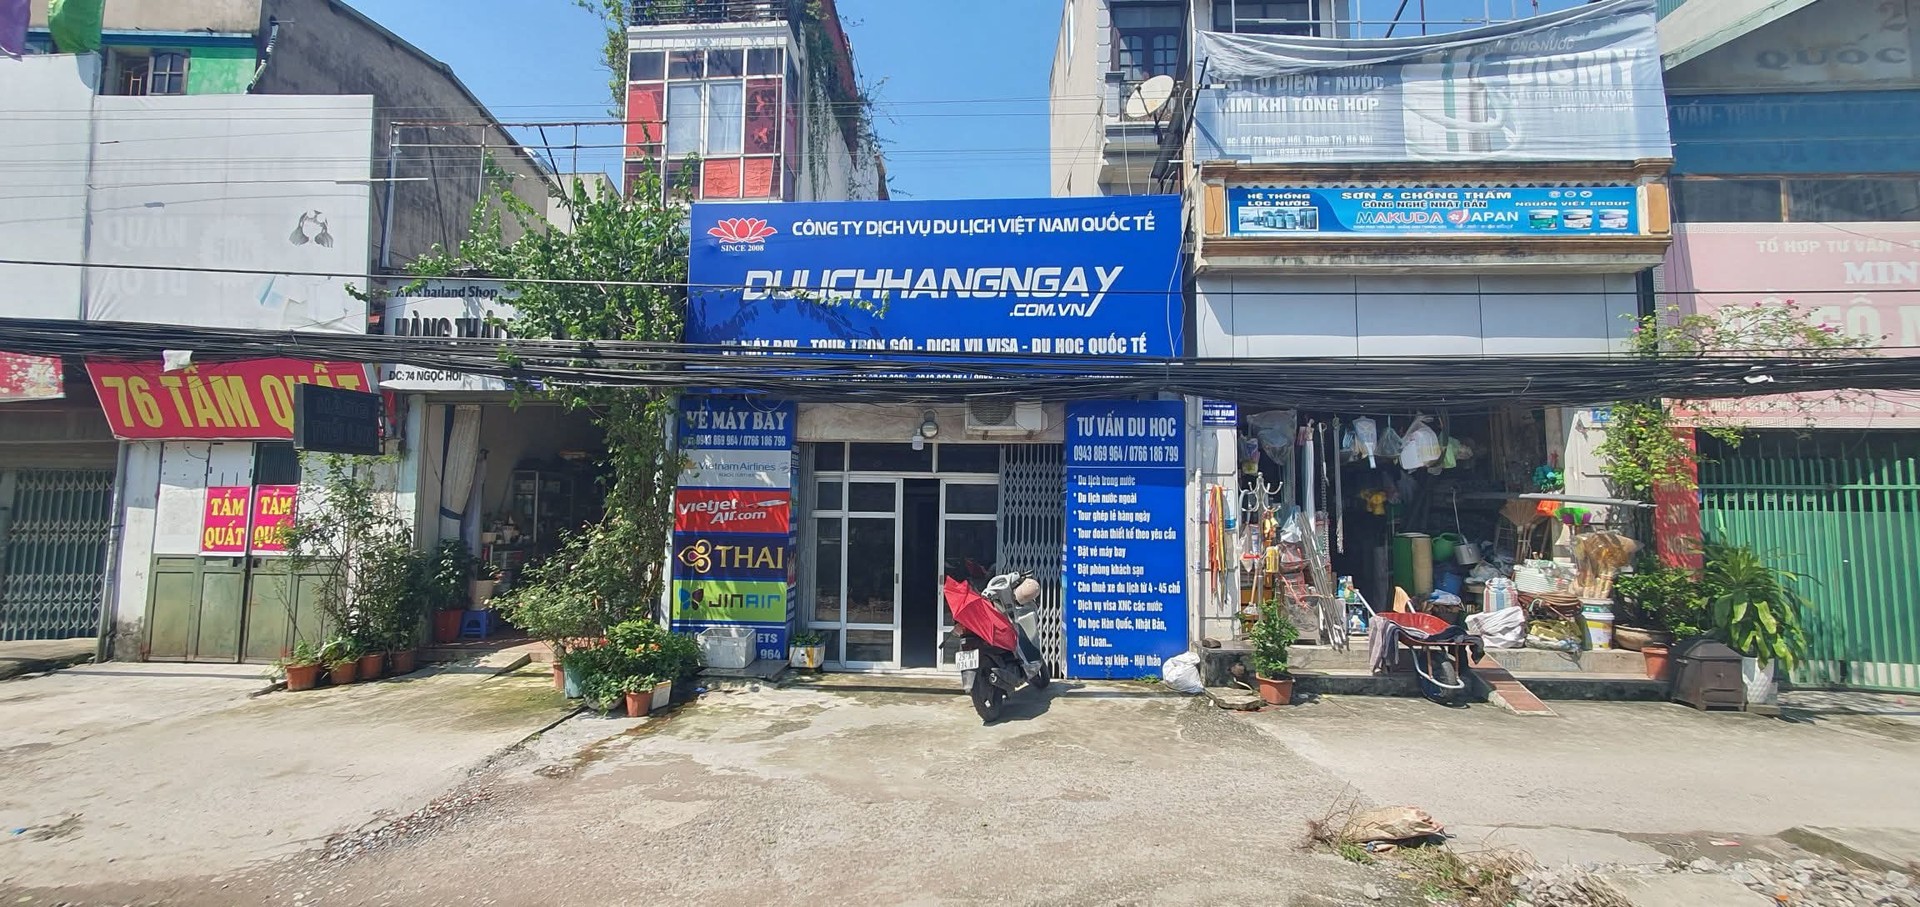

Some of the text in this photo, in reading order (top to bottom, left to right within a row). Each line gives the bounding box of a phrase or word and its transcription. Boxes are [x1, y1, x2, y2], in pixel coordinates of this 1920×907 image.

[1383, 192, 1394, 200] &
[1400, 189, 1458, 200] CHỐNG
[792, 210, 1156, 237] CÔNG TY DỊCH VỤ DU LỊCH VIỆT NAM QUỐC TẾ
[1356, 211, 1444, 224] MAKUDA
[721, 244, 764, 252] SINCE 2008
[468, 286, 498, 301] Shop
[987, 337, 1018, 353] VISA
[1032, 337, 1051, 353] DU
[1088, 332, 1127, 355] QUỐC
[1130, 332, 1147, 354] TẾ
[417, 369, 444, 383] NGỌC
[102, 374, 164, 428] 76
[711, 406, 749, 430] MÁY
[752, 411, 788, 430] BAY
[1077, 410, 1177, 441] TƯ VẤN DU HỌC
[1073, 445, 1092, 461] 0943
[1094, 445, 1107, 461] 869
[1109, 445, 1122, 461] 964
[1129, 445, 1148, 462] 0766
[1149, 446, 1163, 462] 186
[1165, 446, 1179, 462] 799
[699, 461, 776, 472] Vietnam Airlines
[1078, 475, 1086, 486] Du
[1088, 475, 1099, 488] lịch
[1101, 476, 1118, 487] trong
[1078, 492, 1137, 505] Du lịch nước ngoài
[710, 511, 767, 525] Air.com
[1078, 510, 1091, 521] Tour
[1093, 510, 1108, 522] ghép
[1118, 510, 1134, 522] hàng
[1135, 510, 1151, 523] ngày
[204, 519, 245, 549] QUẤT
[1078, 527, 1091, 539] Tour
[1110, 526, 1125, 539] thiết
[1126, 526, 1135, 539] kế
[1135, 528, 1150, 539] theo
[1151, 528, 1163, 540] yêu
[714, 545, 783, 569] THAI
[1099, 546, 1113, 558] máy
[1114, 546, 1126, 558] bay
[1090, 564, 1109, 576] phòng
[1111, 564, 1131, 575] khách
[1078, 581, 1090, 593] Cho
[1092, 582, 1106, 593] thuê
[1107, 583, 1115, 593] xe
[1116, 582, 1125, 593] du
[1126, 582, 1139, 595] lịch
[1148, 583, 1153, 594] 4
[1158, 583, 1167, 594] 45
[1078, 599, 1163, 613] Dịch vụ visa XNC các nước
[1078, 617, 1086, 629] Du
[1088, 618, 1100, 631] học
[1101, 617, 1114, 629] Hàn
[1136, 618, 1151, 632] Nhật
[1152, 617, 1167, 632] Bản,
[760, 648, 781, 660] 964
[1087, 654, 1103, 666] chức
[1114, 654, 1129, 668] kiện
[1134, 655, 1145, 668] Hội
[1147, 654, 1161, 667] thảo
